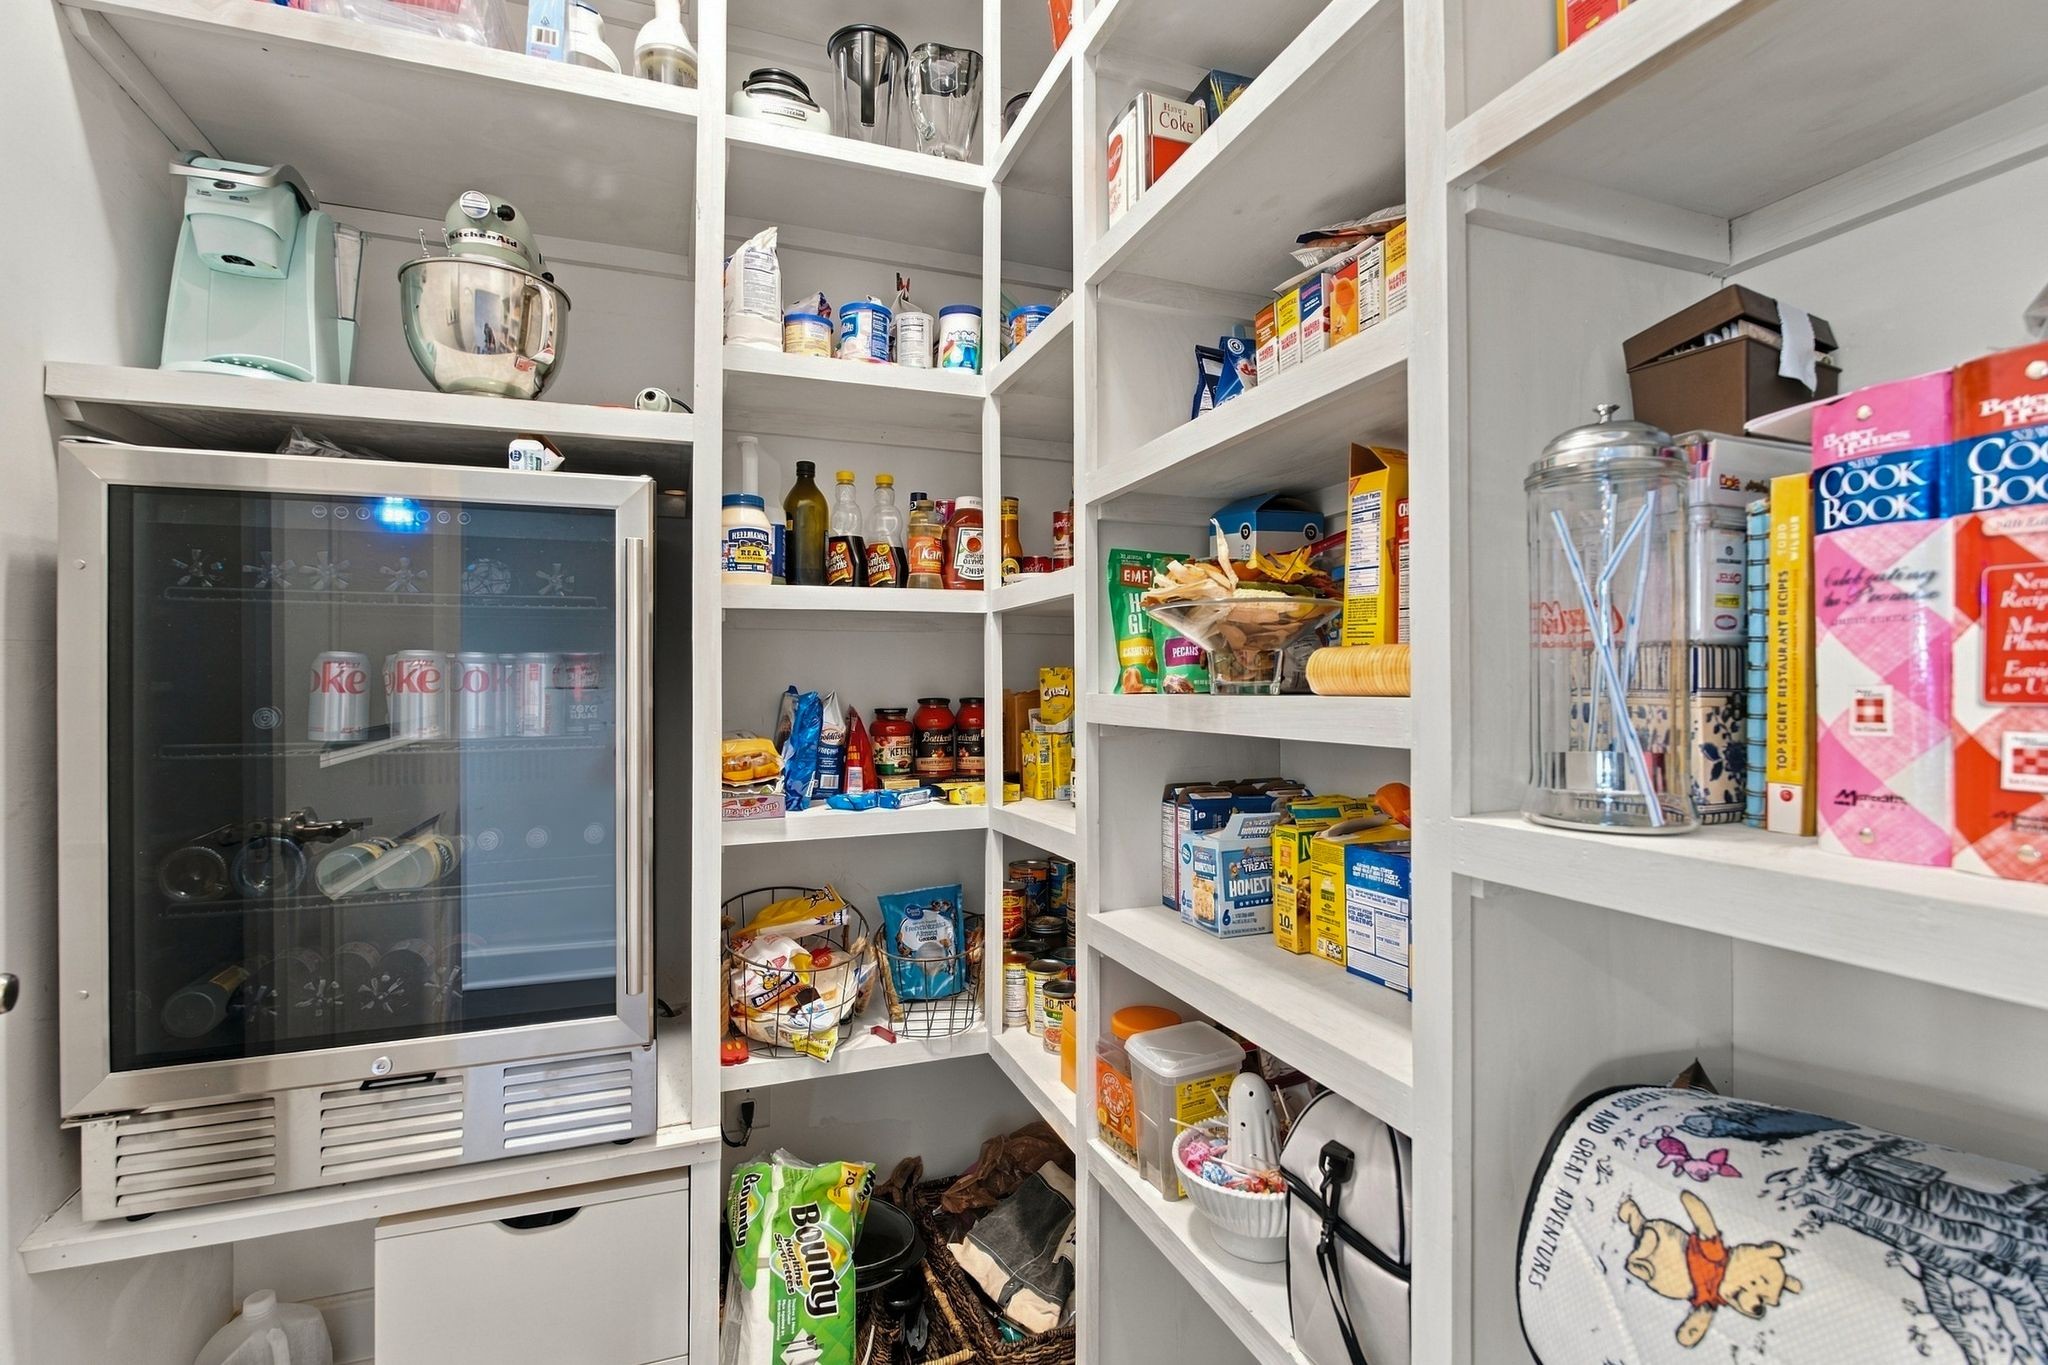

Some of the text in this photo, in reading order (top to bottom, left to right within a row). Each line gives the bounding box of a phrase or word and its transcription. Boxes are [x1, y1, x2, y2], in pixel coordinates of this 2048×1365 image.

[1159, 110, 1194, 134] Coke
[449, 230, 518, 248] KitchenAid
[1823, 427, 1878, 449] Better
[1837, 429, 1912, 457] Homes
[1819, 459, 1929, 500] COOK
[1822, 491, 1928, 530] BOOK
[741, 549, 762, 557] REAL
[1172, 644, 1200, 658] PECANS
[1777, 571, 1788, 770] TOP SECRET RESTAURANT RECIPES
[1043, 686, 1071, 701] Crush
[1243, 861, 1274, 873] TREATS
[1229, 876, 1273, 898] HOMEST
[1222, 909, 1231, 926] 6
[1587, 1109, 1620, 1135] AND
[1564, 1137, 1597, 1185] GREAT
[735, 1173, 761, 1248] Bounty
[1530, 1187, 1575, 1291] ADVENTURES
[772, 1232, 795, 1295] Serviettes
[784, 1237, 804, 1288] Napkins
[789, 1202, 841, 1319] Bounty
